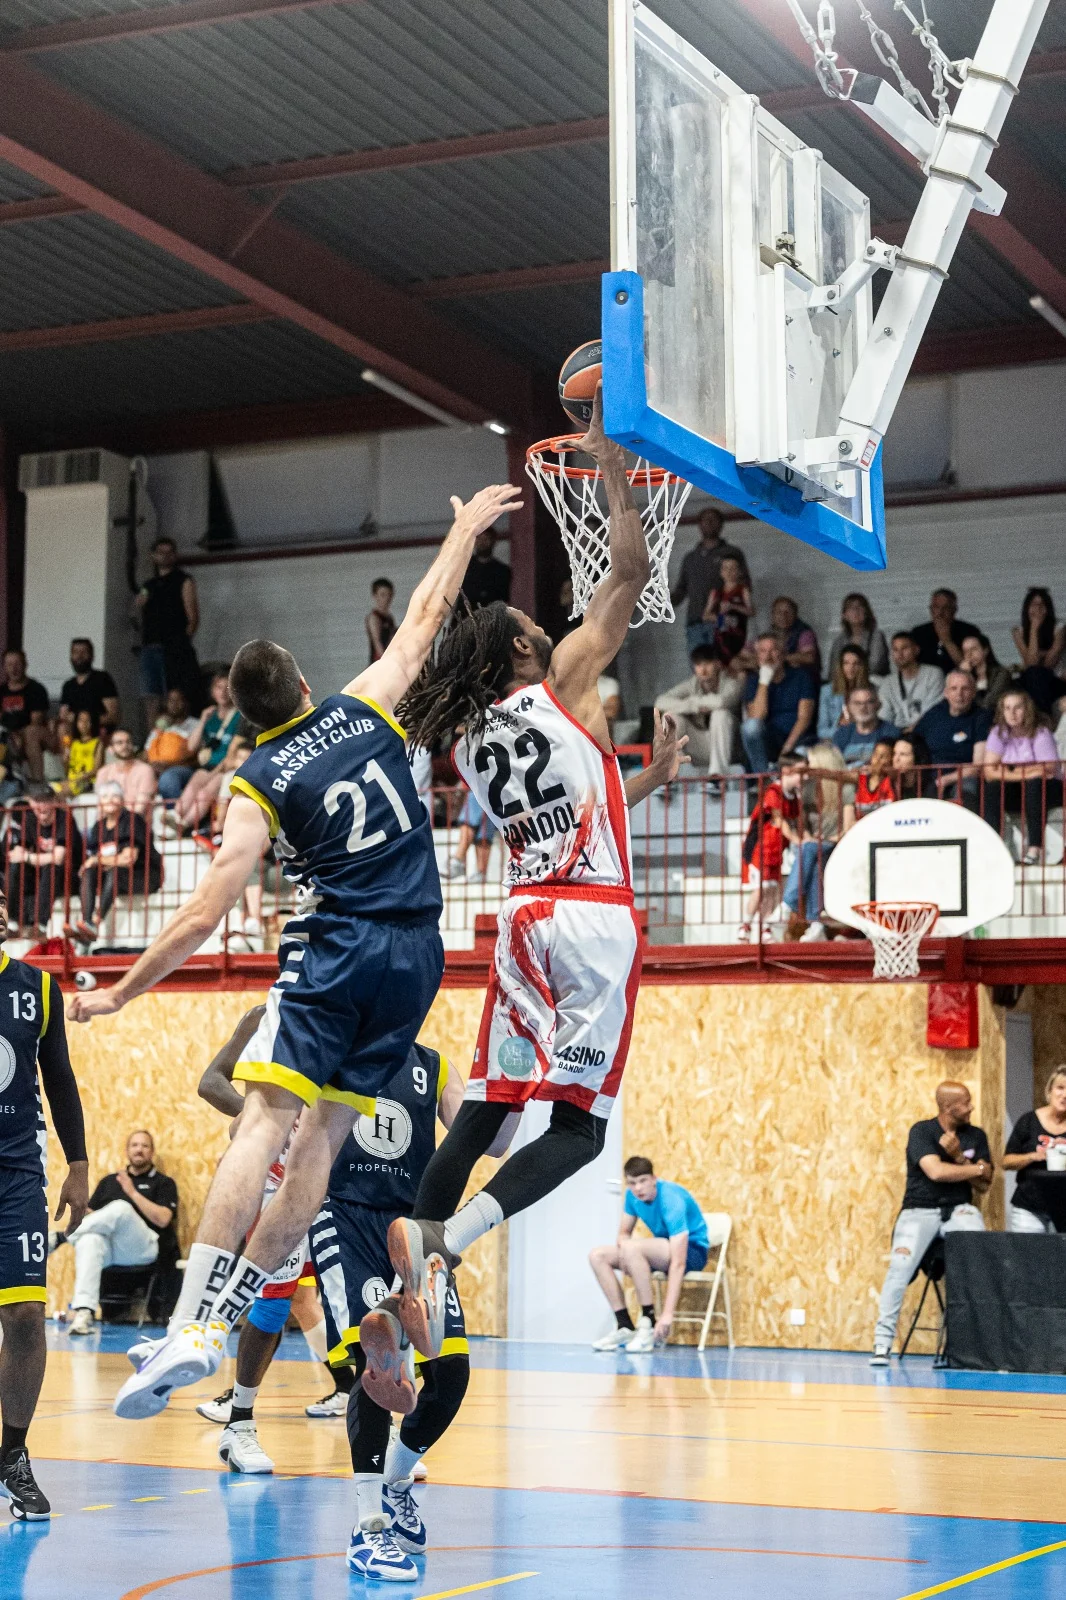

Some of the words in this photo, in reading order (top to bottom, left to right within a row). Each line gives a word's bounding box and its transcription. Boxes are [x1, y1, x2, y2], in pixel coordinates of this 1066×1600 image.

[270, 706, 348, 767] MENTON
[271, 736, 330, 793] BASKET
[329, 718, 376, 745] CLUB
[474, 727, 567, 820] 22
[323, 758, 413, 854] 21
[894, 818, 931, 827] MARTY
[8, 990, 37, 1022] 13
[553, 1045, 606, 1067] ASINO
[412, 1066, 428, 1096] 9
[371, 1113, 397, 1143] H
[17, 1231, 45, 1263] 13
[285, 1253, 300, 1269] rpi
[446, 1287, 461, 1318] 9
